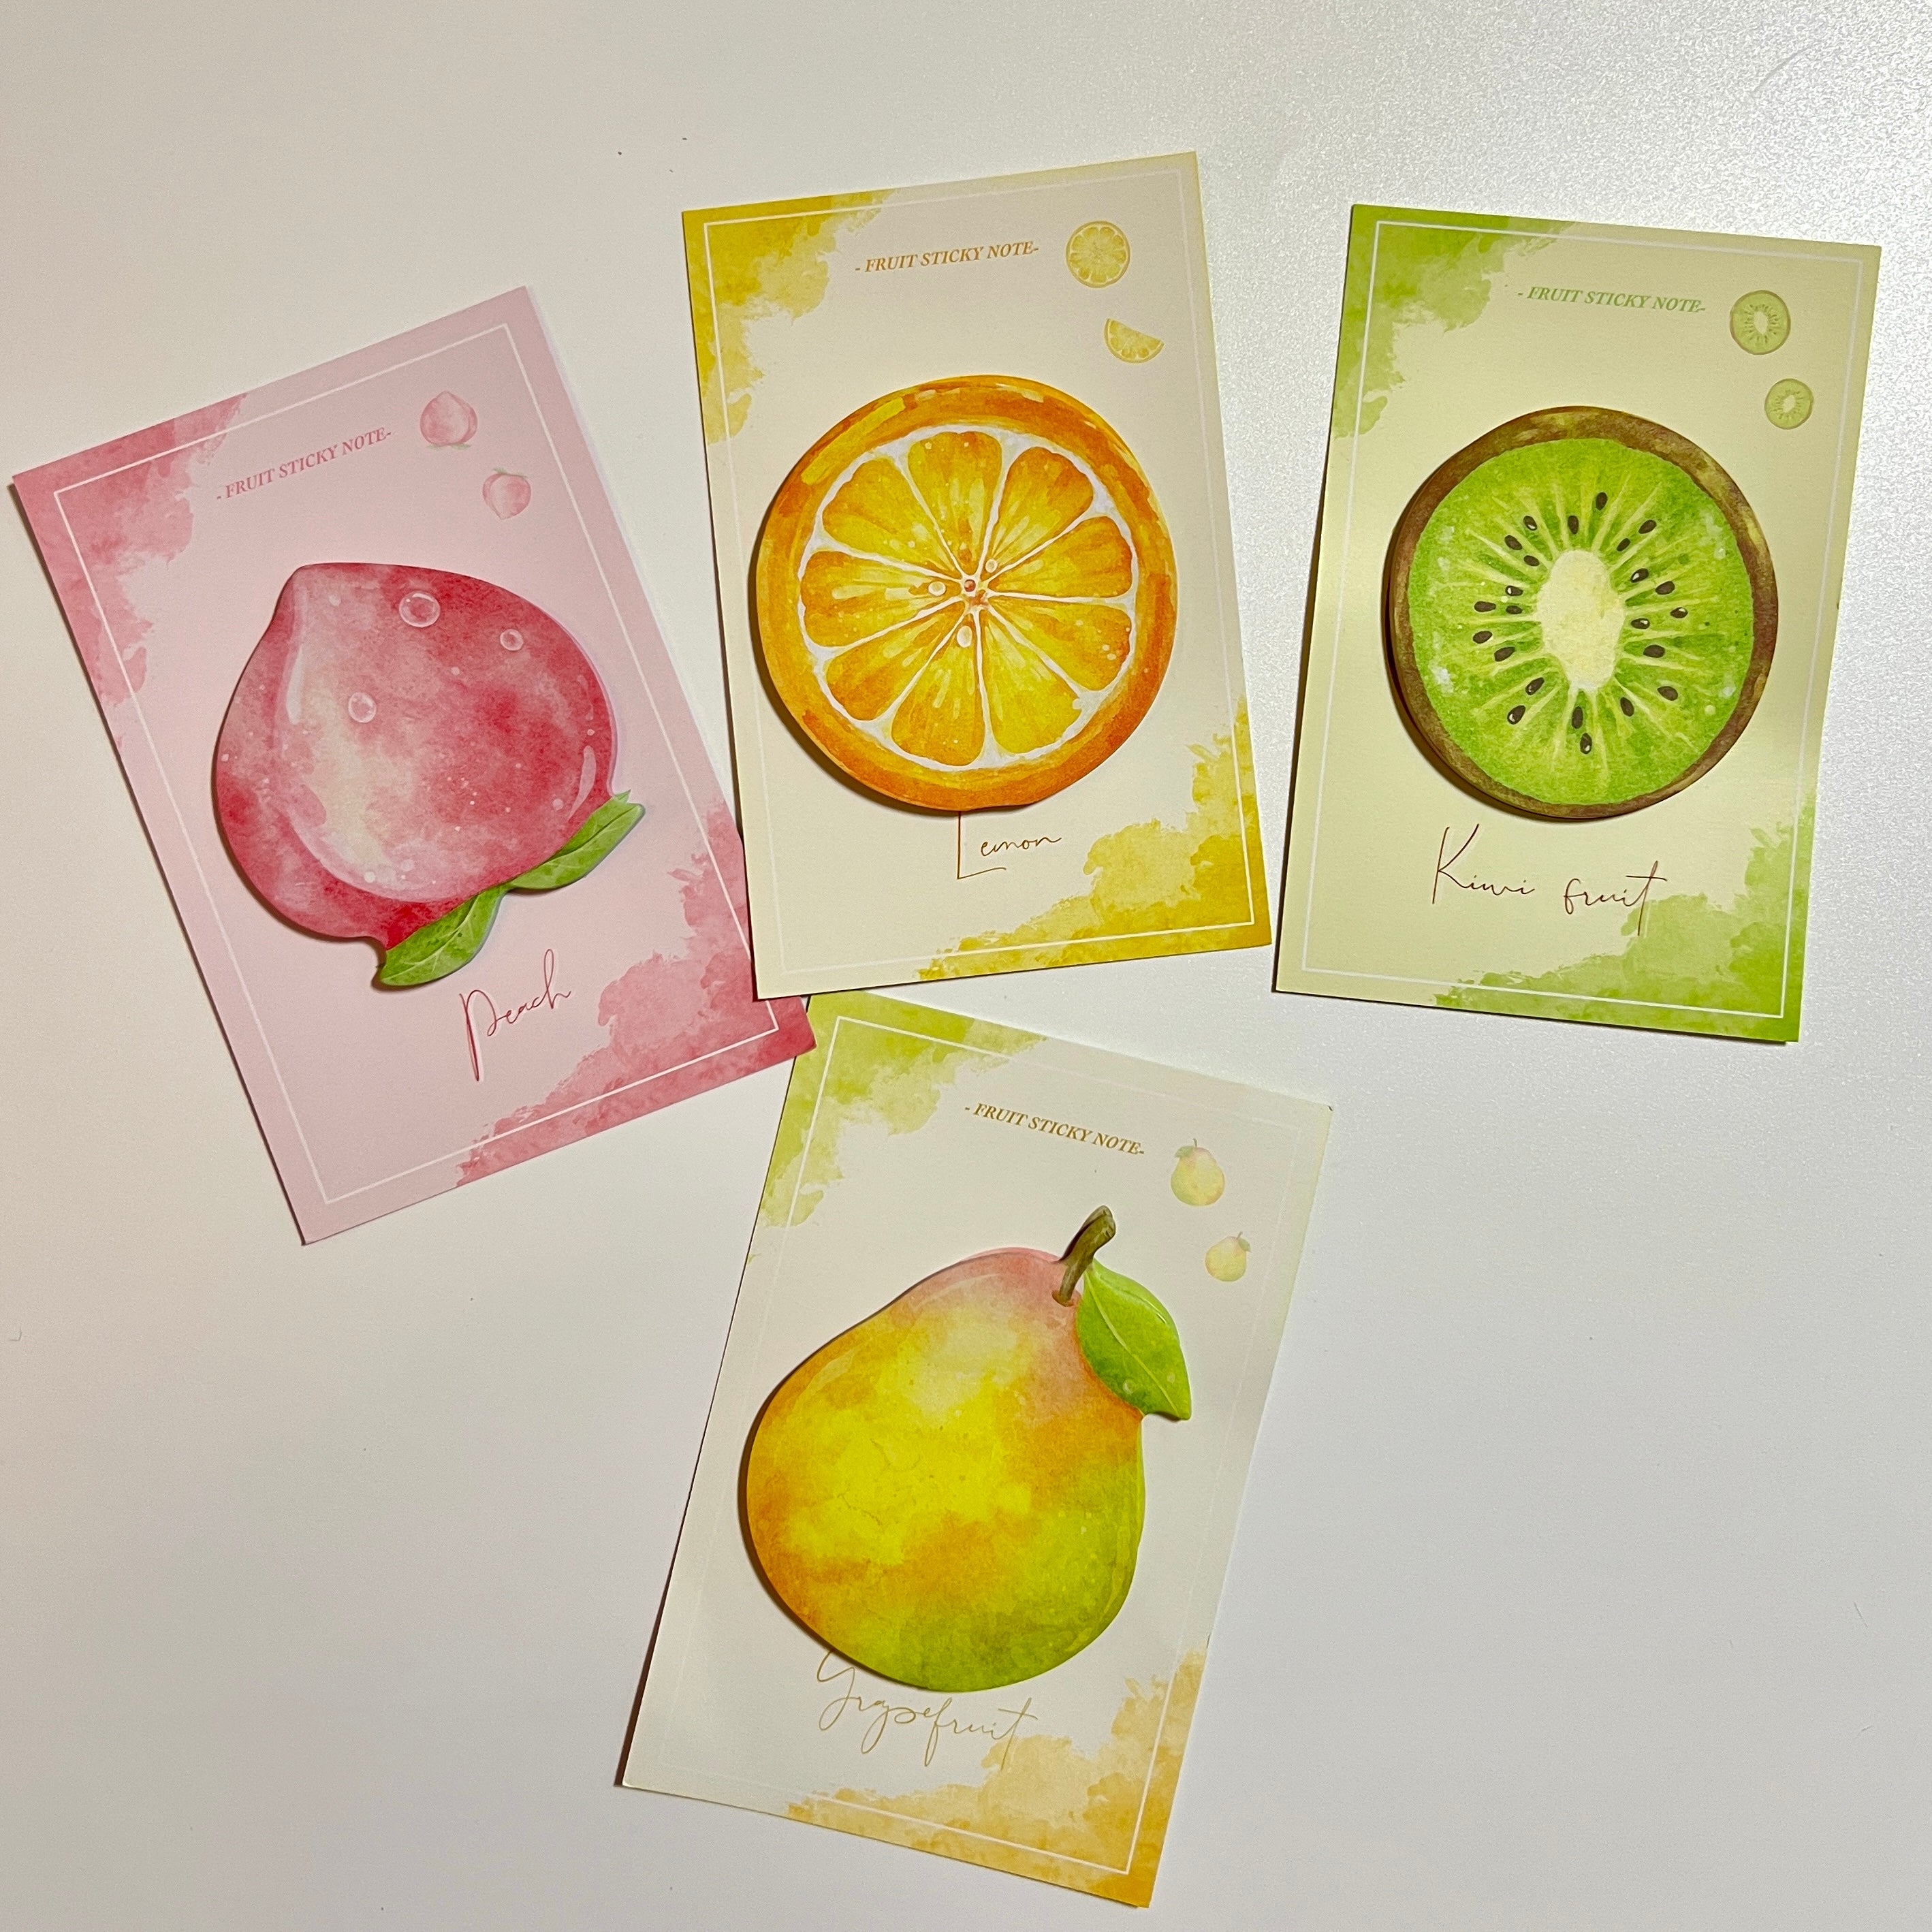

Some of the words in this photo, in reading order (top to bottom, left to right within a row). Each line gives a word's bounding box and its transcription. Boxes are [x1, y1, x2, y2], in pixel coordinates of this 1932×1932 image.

[865, 254, 918, 272] FRUIT
[920, 246, 984, 266] STICKY
[1527, 286, 1583, 303] FRUIT
[1585, 291, 1650, 309] STICKY
[225, 468, 276, 499] FRUIT
[279, 444, 338, 478] STICKY
[957, 810, 1062, 880] Lemon
[1432, 823, 1536, 905] Kiwi
[1564, 860, 1668, 936] fruit
[973, 1103, 1028, 1126] FRUIT
[1028, 1116, 1093, 1142] STICKY
[817, 1649, 1039, 1771] Grapefruit
